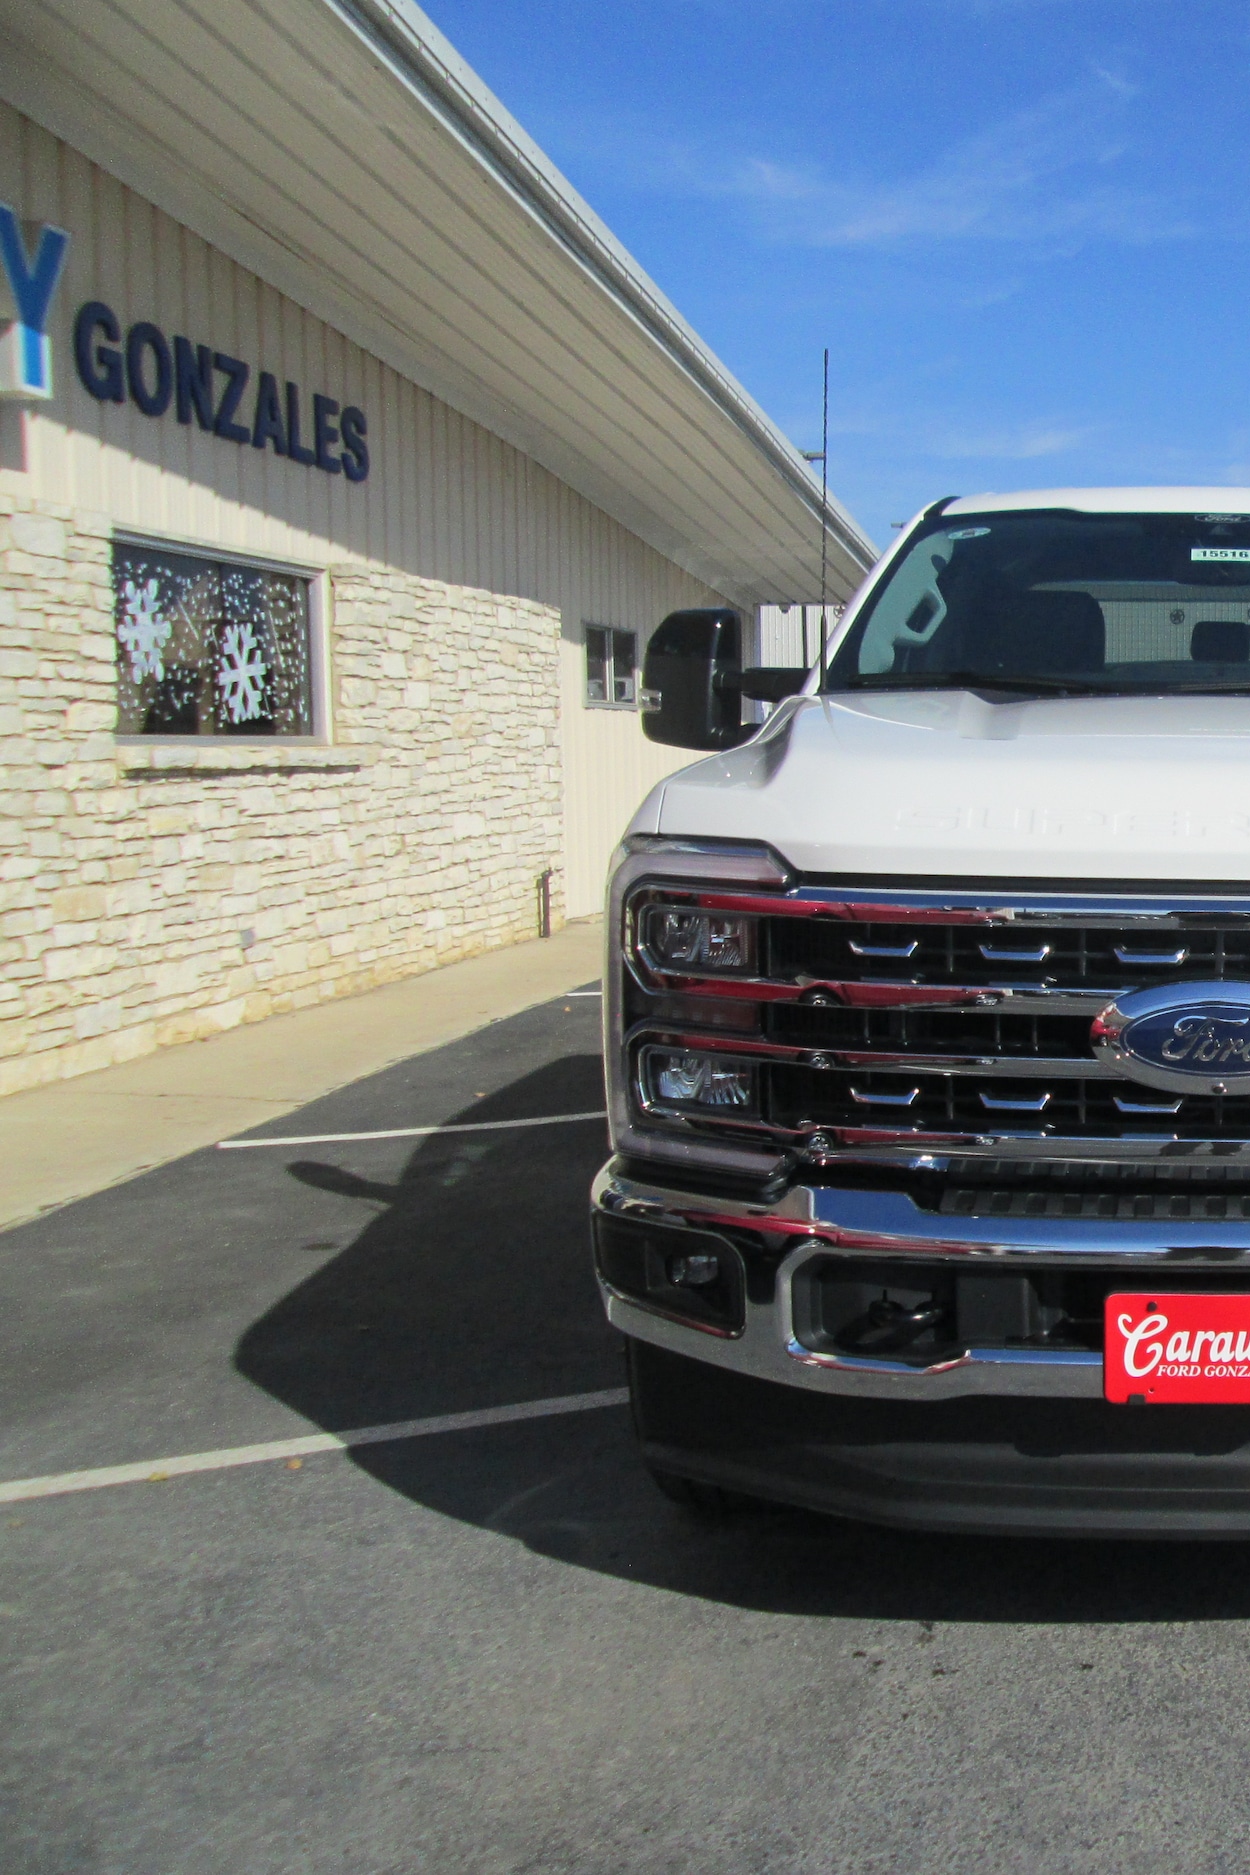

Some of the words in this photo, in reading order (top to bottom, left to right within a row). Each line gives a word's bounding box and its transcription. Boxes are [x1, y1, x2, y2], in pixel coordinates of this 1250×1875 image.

[73, 301, 370, 482] GONZALES
[1201, 550, 1249, 558] 15516
[894, 806, 1250, 837] SUPER
[1156, 1364, 1201, 1377] FORD
